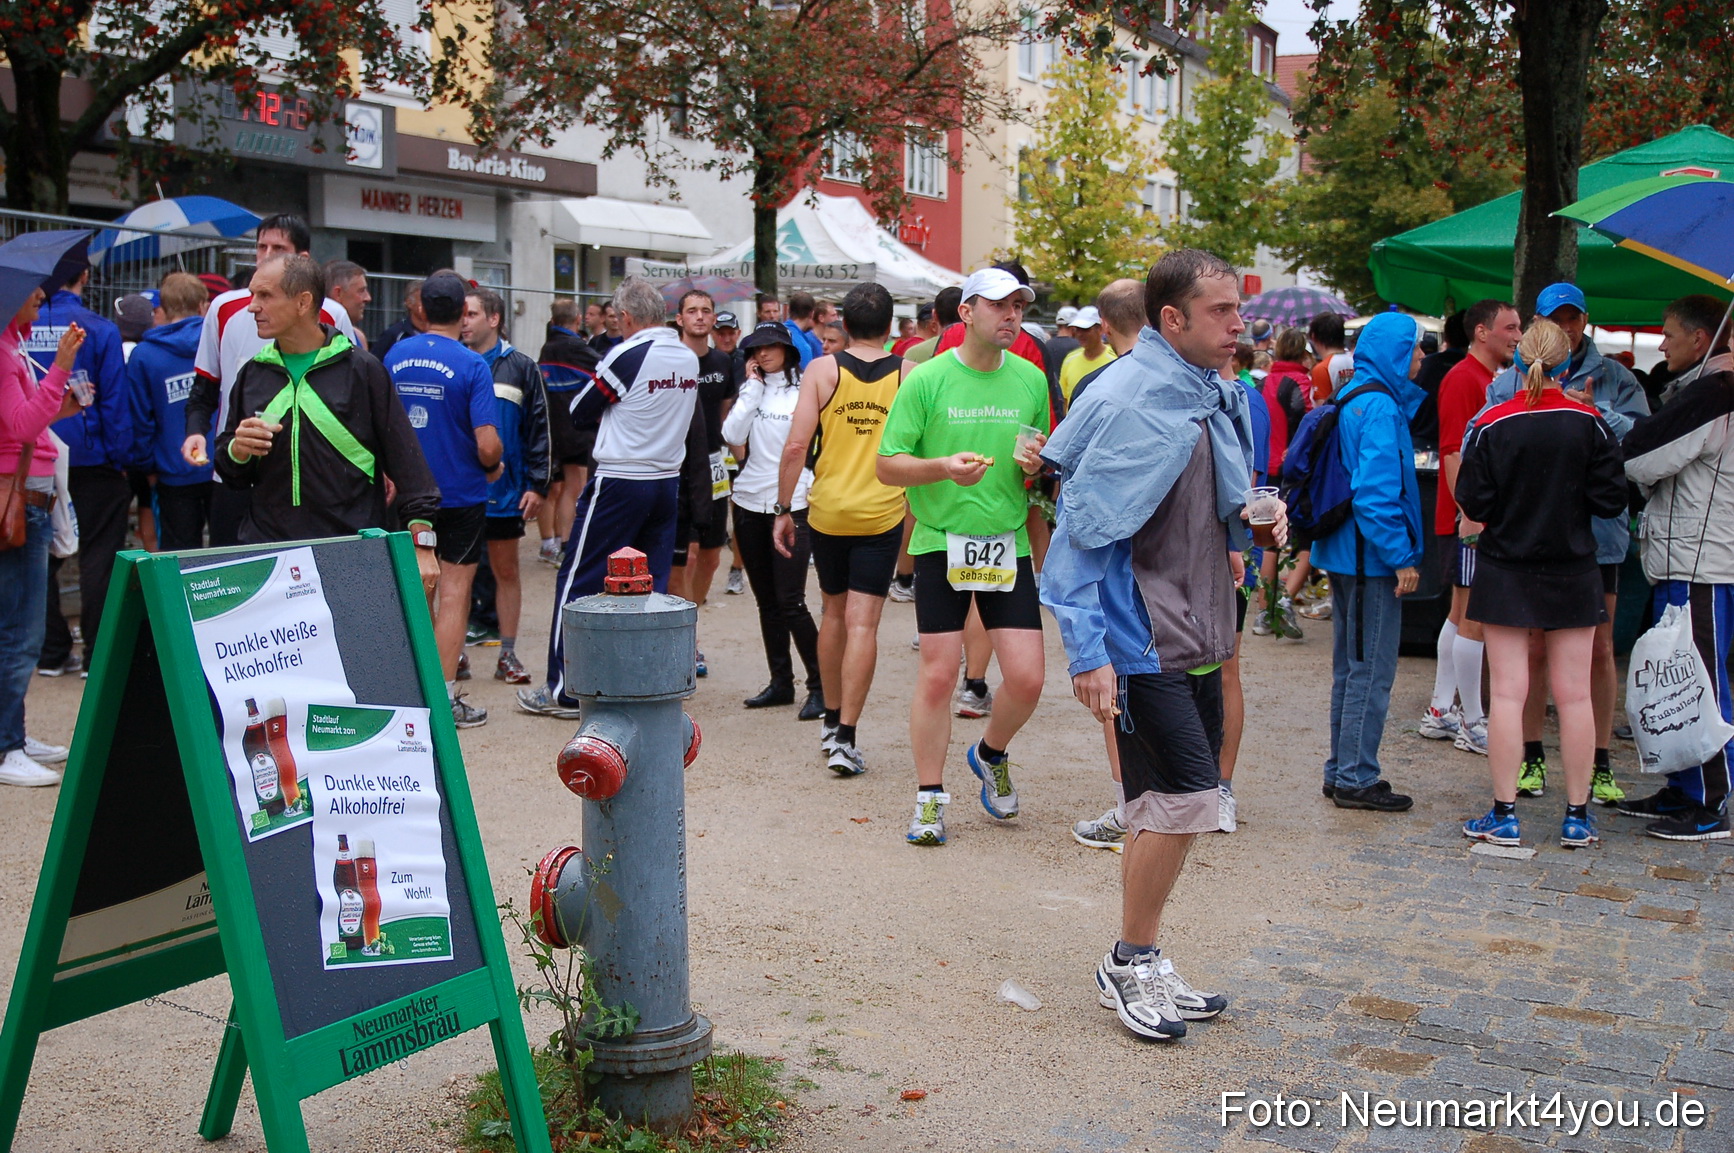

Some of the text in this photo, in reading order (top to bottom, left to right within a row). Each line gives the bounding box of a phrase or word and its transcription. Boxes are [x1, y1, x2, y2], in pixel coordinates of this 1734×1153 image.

[448, 148, 546, 183] Bavaria-Kino
[417, 195, 463, 220] HERZEN
[815, 262, 833, 278] 63
[841, 263, 859, 279] 52
[648, 372, 677, 394] great
[846, 401, 864, 411] 1883
[855, 427, 873, 436] Team
[964, 541, 1006, 567] 642
[190, 577, 221, 592] Stadtlauf
[193, 585, 242, 602] Neumarkt 2011
[215, 621, 318, 660] Dunkle Weiße
[224, 648, 303, 683] Alkoholfrei
[312, 715, 340, 724] Stadtlauf
[312, 725, 343, 734] Neumarkt
[324, 774, 421, 792] Dunkle Weiße
[329, 797, 406, 815] Alkoholfrei
[391, 871, 413, 884] Zum
[404, 886, 432, 899] Wohl!
[352, 994, 438, 1041] Neumarkter
[338, 1011, 461, 1077] Lammsbräu
